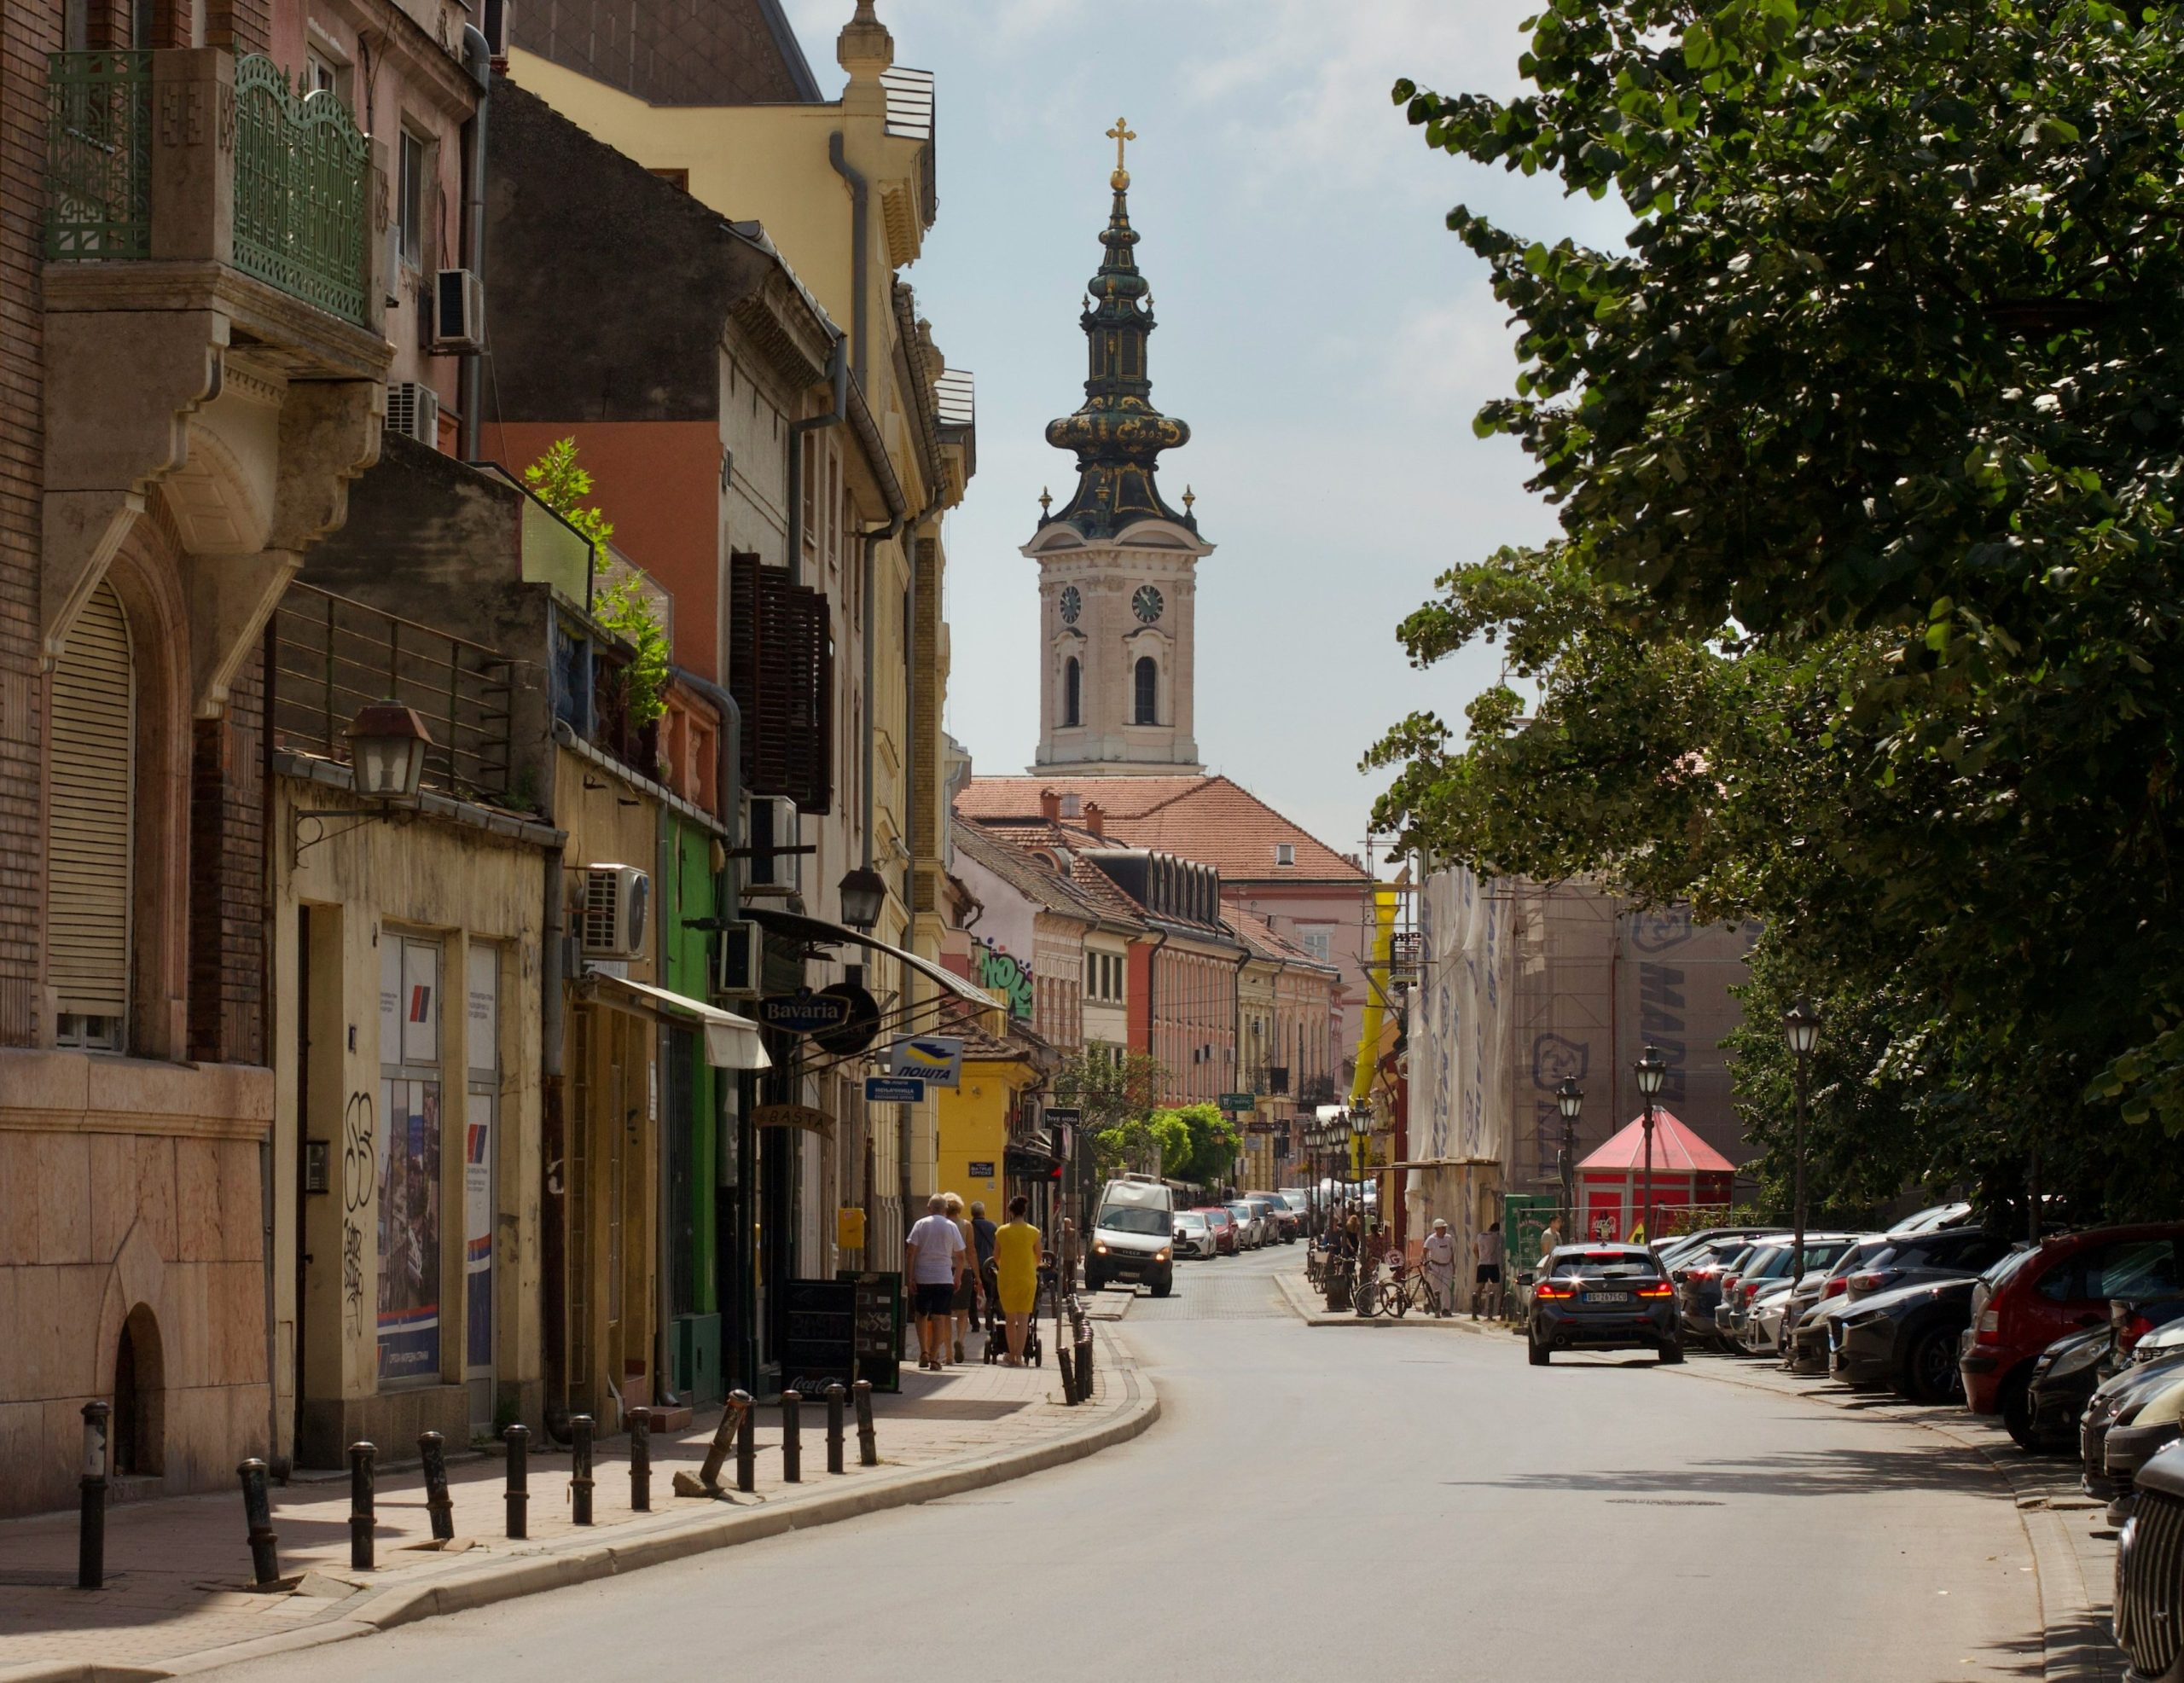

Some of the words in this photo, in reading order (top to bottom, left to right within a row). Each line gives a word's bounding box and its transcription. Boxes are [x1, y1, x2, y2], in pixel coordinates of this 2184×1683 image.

[768, 1002, 839, 1019] Bavaria
[898, 1066, 951, 1080] ПОШТА
[790, 1375, 845, 1395] CocaC
